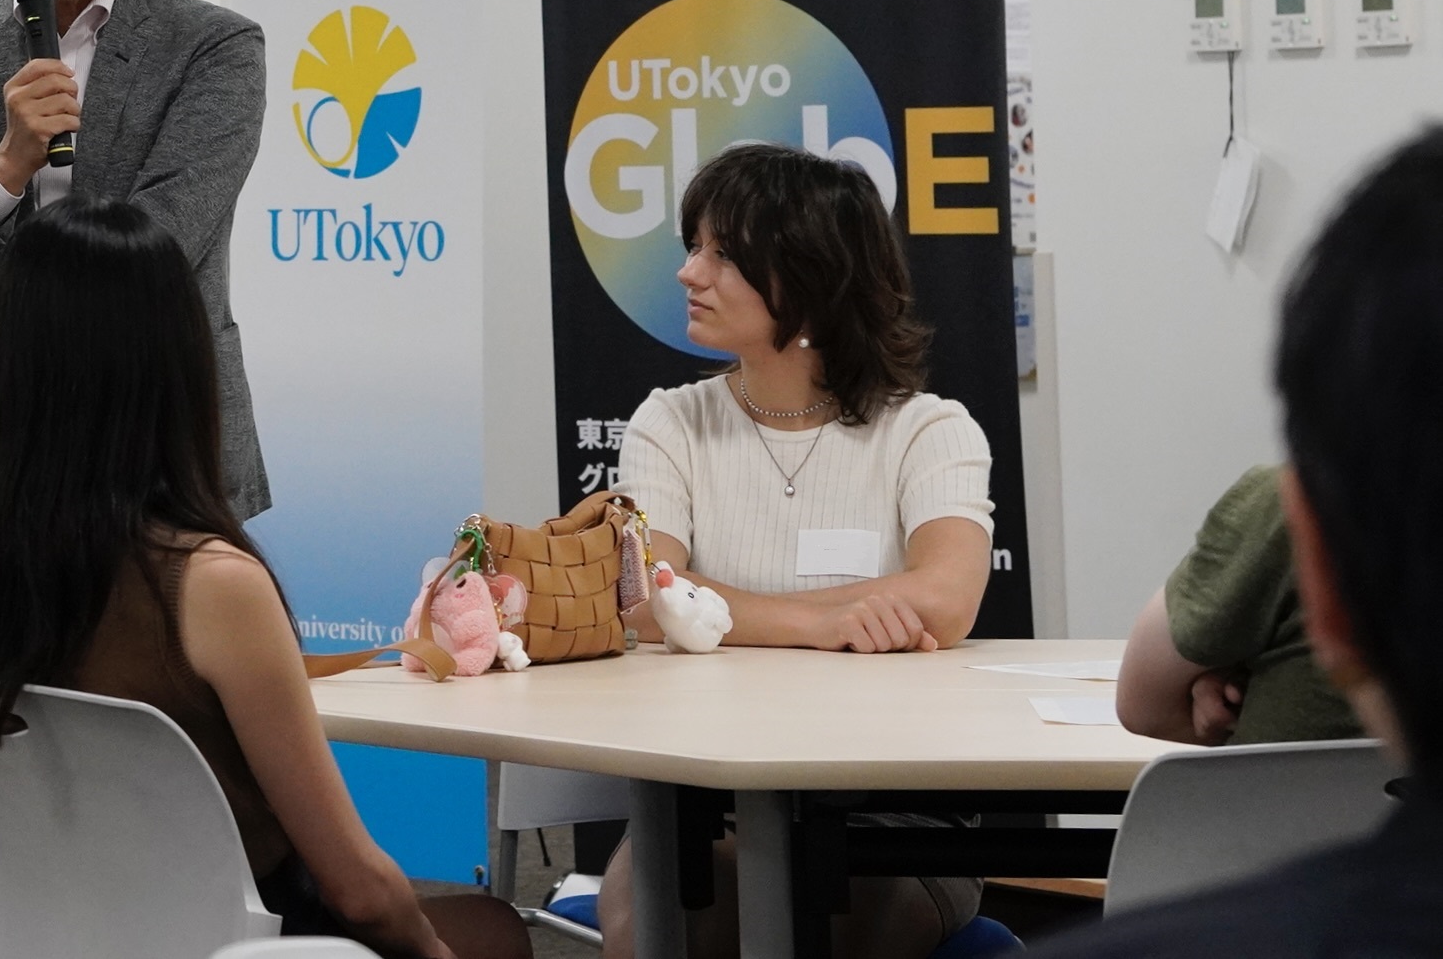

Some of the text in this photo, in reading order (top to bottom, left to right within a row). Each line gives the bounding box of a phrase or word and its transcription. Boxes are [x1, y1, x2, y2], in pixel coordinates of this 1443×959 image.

[608, 55, 791, 107] UTokyo
[564, 105, 1000, 239] GlbE
[267, 202, 446, 277] UTokyo
[298, 614, 405, 648] niversity o
